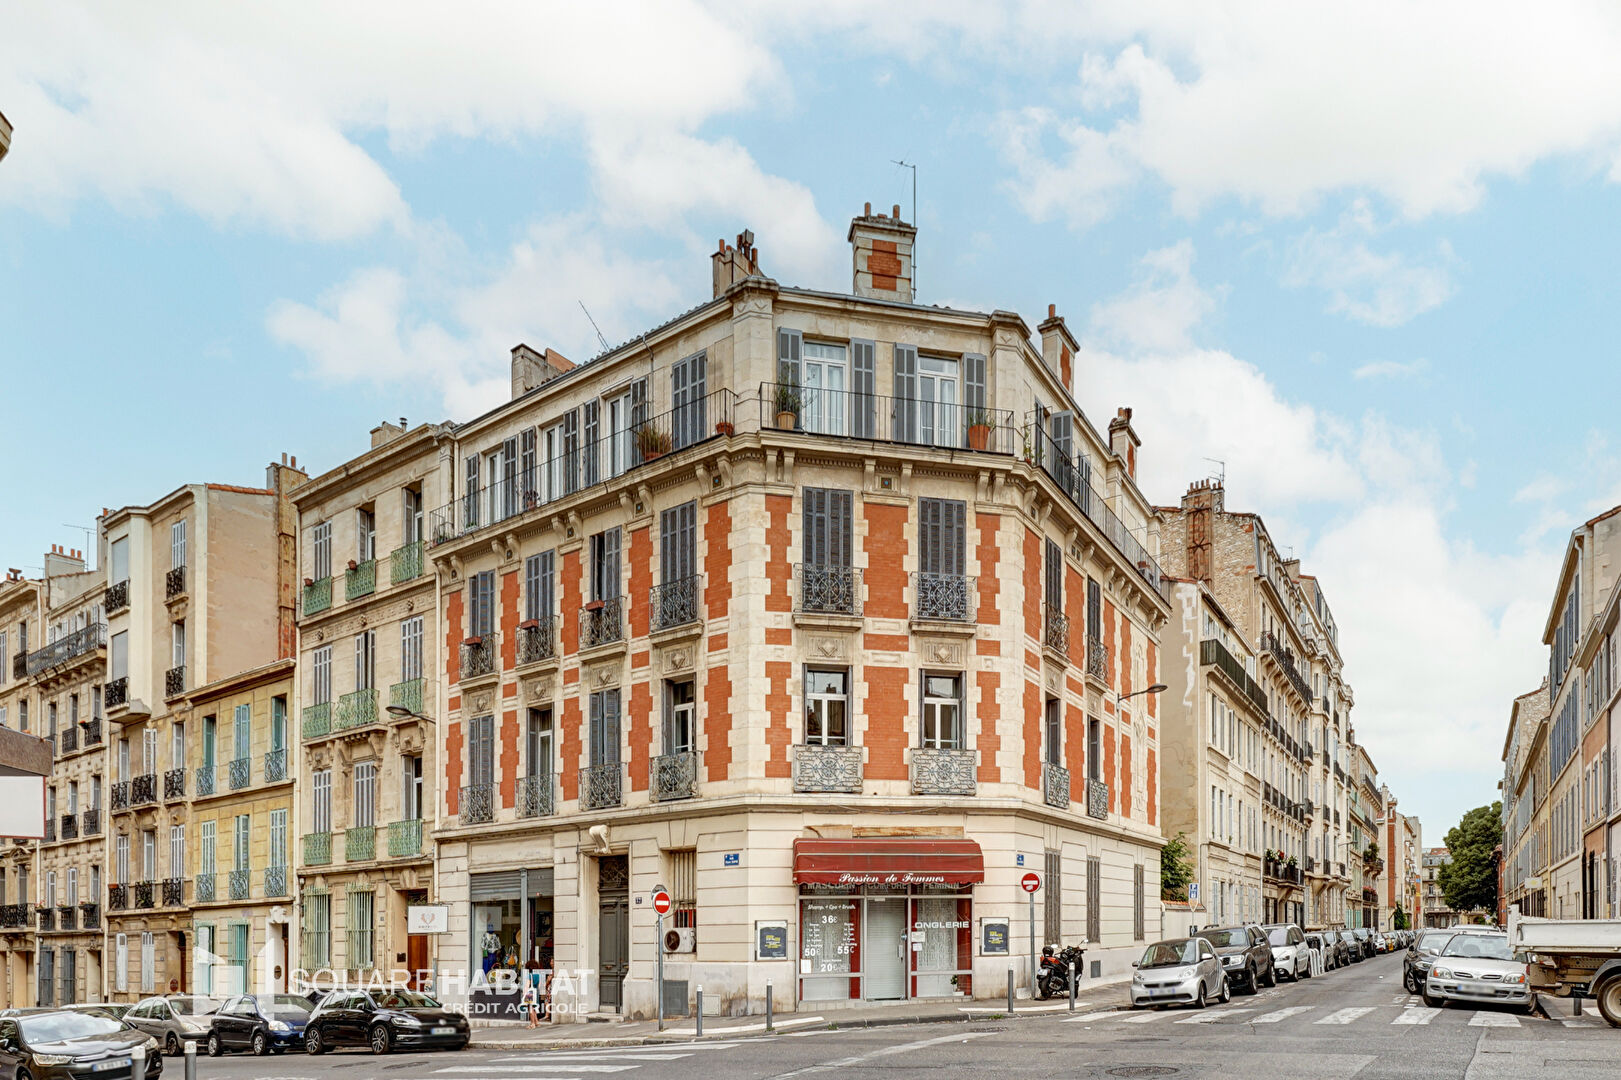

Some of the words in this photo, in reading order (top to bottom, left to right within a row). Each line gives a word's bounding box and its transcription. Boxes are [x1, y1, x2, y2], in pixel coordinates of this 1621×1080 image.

[838, 873, 879, 883] Passion
[885, 873, 898, 883] de
[902, 872, 945, 883] Femmes
[914, 921, 970, 929] ONGLERIE
